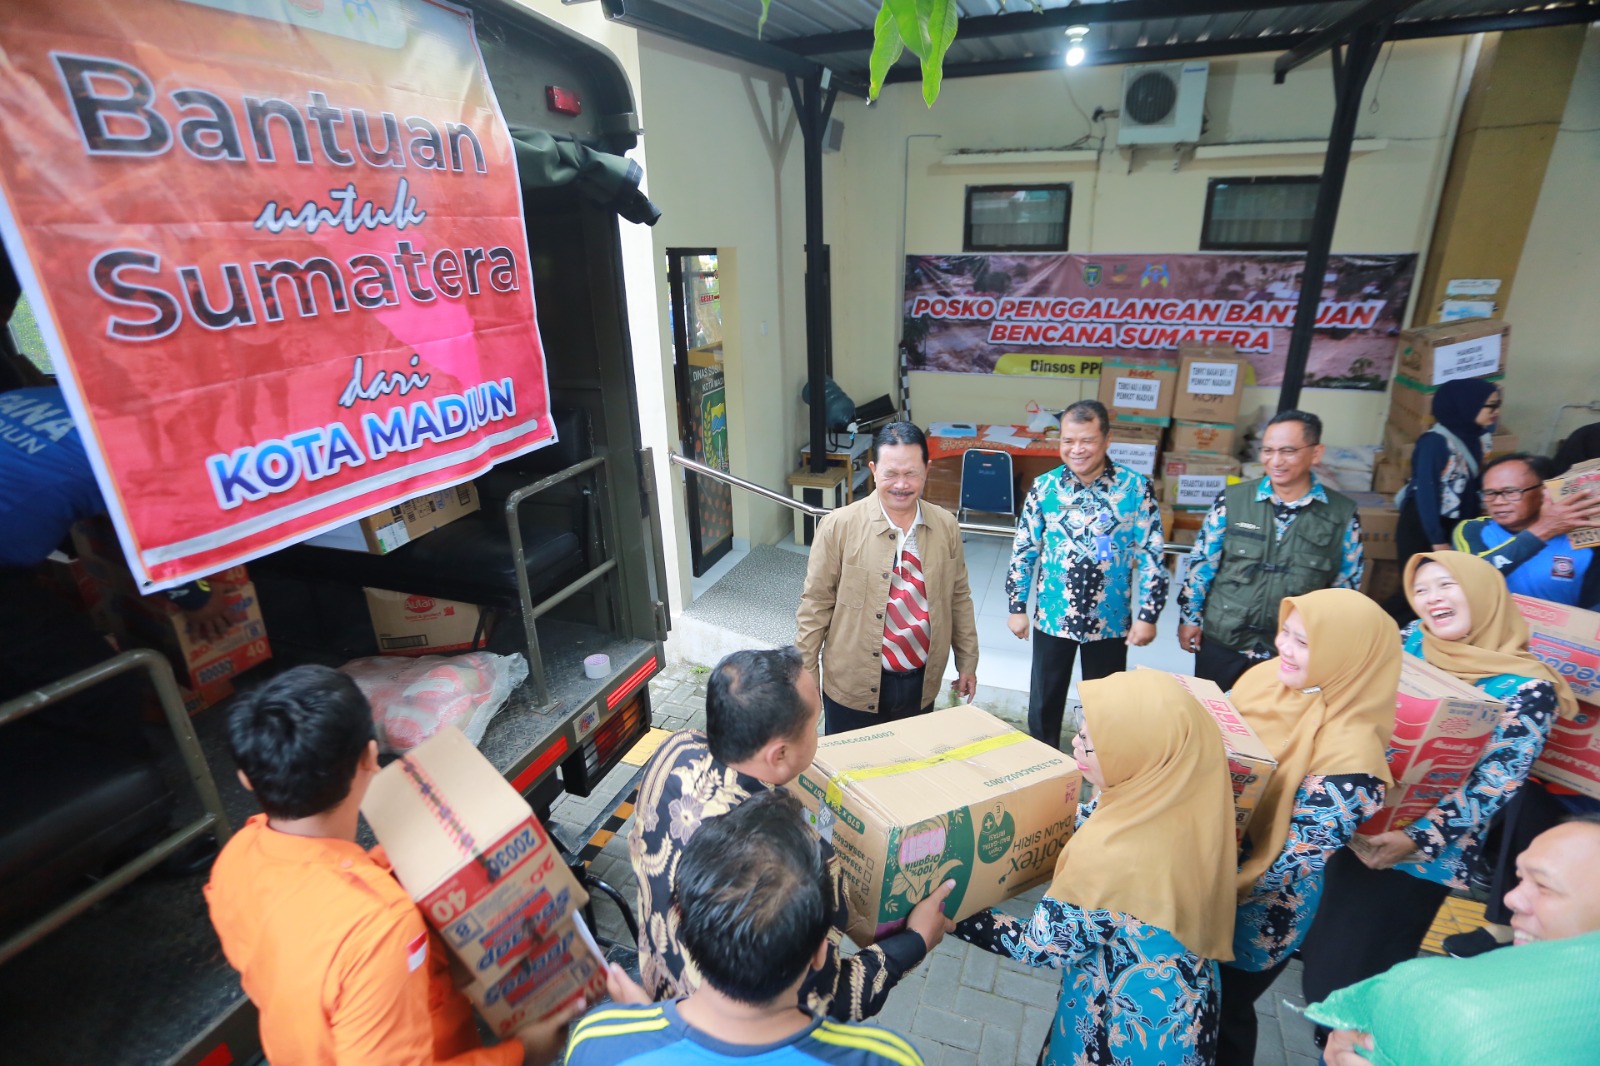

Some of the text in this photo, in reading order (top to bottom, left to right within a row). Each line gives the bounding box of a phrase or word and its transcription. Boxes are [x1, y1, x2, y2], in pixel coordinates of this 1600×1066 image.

[50, 51, 487, 174] Bantuan
[252, 177, 427, 234] untuk
[89, 240, 520, 344] Sumatera
[912, 297, 996, 318] POSKO
[998, 299, 1223, 322] PENGGALANGAN
[990, 323, 1271, 350] BENCANA SUMATERA
[337, 355, 431, 408] dari
[1030, 359, 1102, 375] Dinsos PP
[208, 377, 518, 509] KOTA MADIUN
[1012, 815, 1072, 854] DAUN SIRIH
[904, 854, 941, 873] Organik
[431, 886, 468, 924] 40
[478, 887, 571, 971] Seaap
